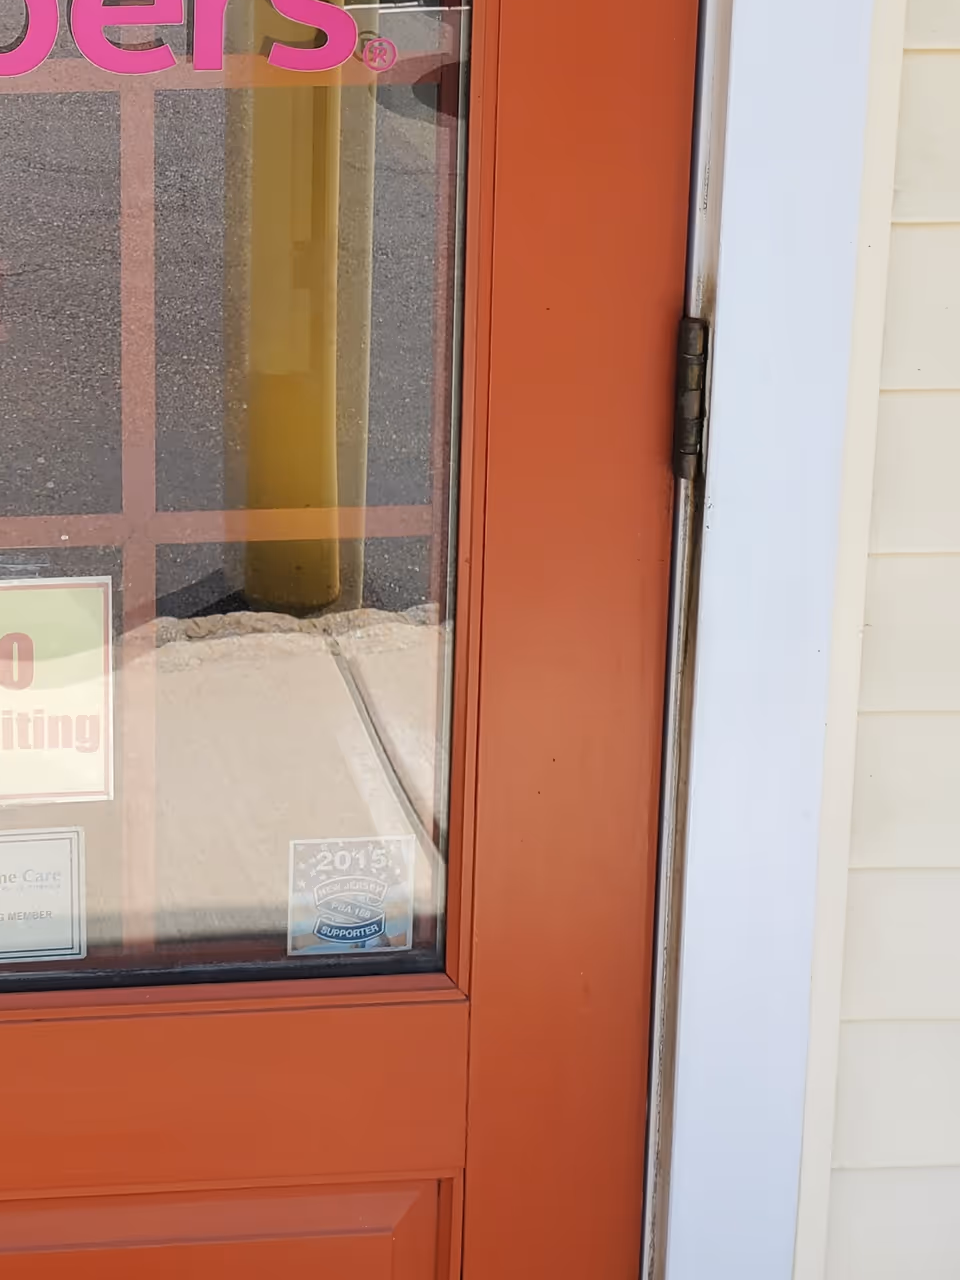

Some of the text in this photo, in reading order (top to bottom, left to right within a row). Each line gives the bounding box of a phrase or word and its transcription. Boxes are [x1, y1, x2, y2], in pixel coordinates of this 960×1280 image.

[315, 848, 388, 872] 2015
[22, 868, 62, 884] Care
[8, 909, 53, 922] MEMBER
[320, 923, 380, 938] SUPPORTER
